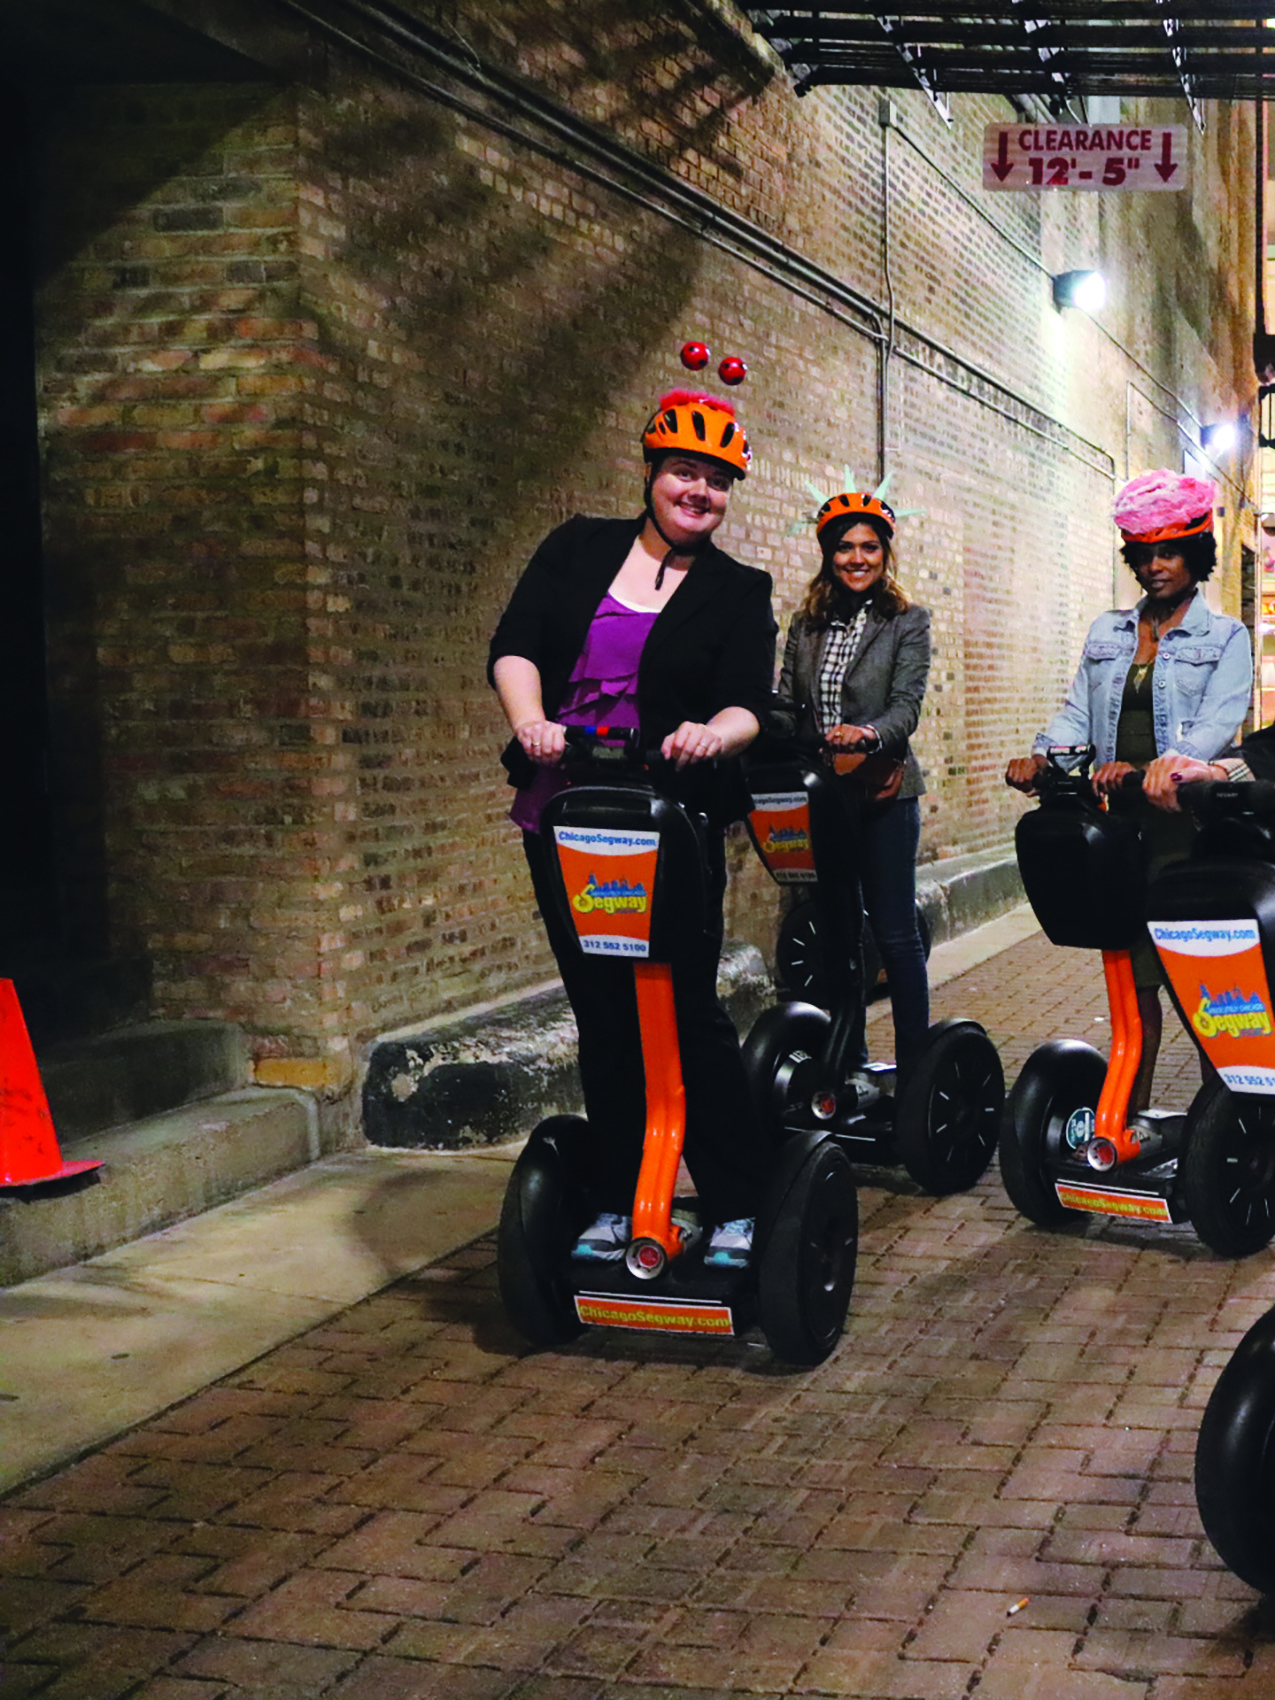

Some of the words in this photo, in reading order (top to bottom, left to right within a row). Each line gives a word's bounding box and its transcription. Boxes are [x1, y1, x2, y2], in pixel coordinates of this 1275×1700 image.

[1018, 129, 1152, 151] CLEARANCE
[558, 831, 656, 847] ChicagoSegway.com
[572, 884, 648, 914] Segway
[1154, 928, 1256, 943] ChicagoSegway.com
[583, 940, 601, 949] 312
[603, 941, 621, 951] 552
[623, 942, 647, 952] 5100
[1193, 996, 1272, 1038] Segway
[1224, 1073, 1244, 1085] 312
[1247, 1075, 1265, 1086] 552
[579, 1305, 729, 1327] ChicagoSegway.com
